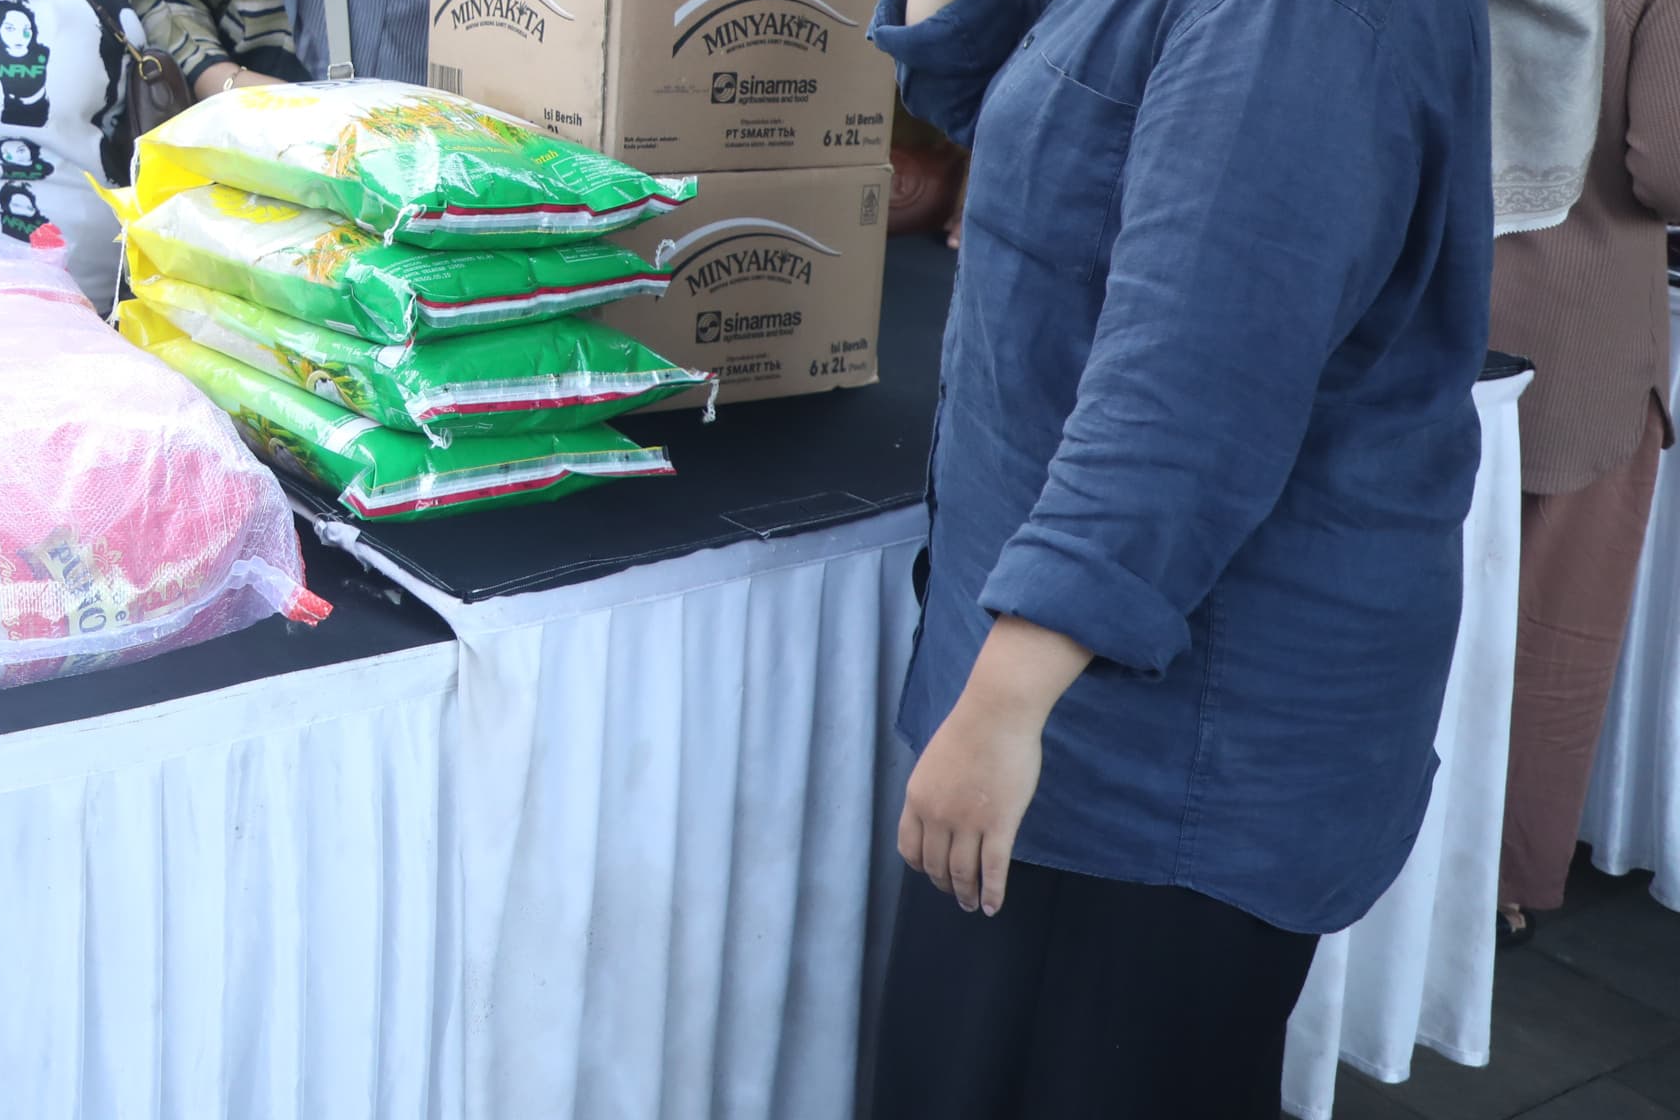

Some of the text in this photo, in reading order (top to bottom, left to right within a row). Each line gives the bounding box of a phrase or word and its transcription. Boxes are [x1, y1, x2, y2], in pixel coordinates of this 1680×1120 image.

[702, 12, 829, 57] MINYAKITA
[739, 76, 817, 95] sinarmas
[544, 108, 583, 127] Isi Bersih
[857, 112, 884, 126] Bersih
[726, 126, 796, 139] PT SMART Tbk
[823, 130, 832, 146] 6
[834, 133, 843, 146] x
[845, 129, 861, 145] 2L
[685, 248, 812, 296] MINYAKITA
[724, 310, 802, 333] sinarmas
[726, 363, 763, 376] SMART
[764, 360, 782, 372] Tbk
[809, 359, 818, 377] 6
[821, 362, 829, 376] x
[831, 356, 848, 374] 2L
